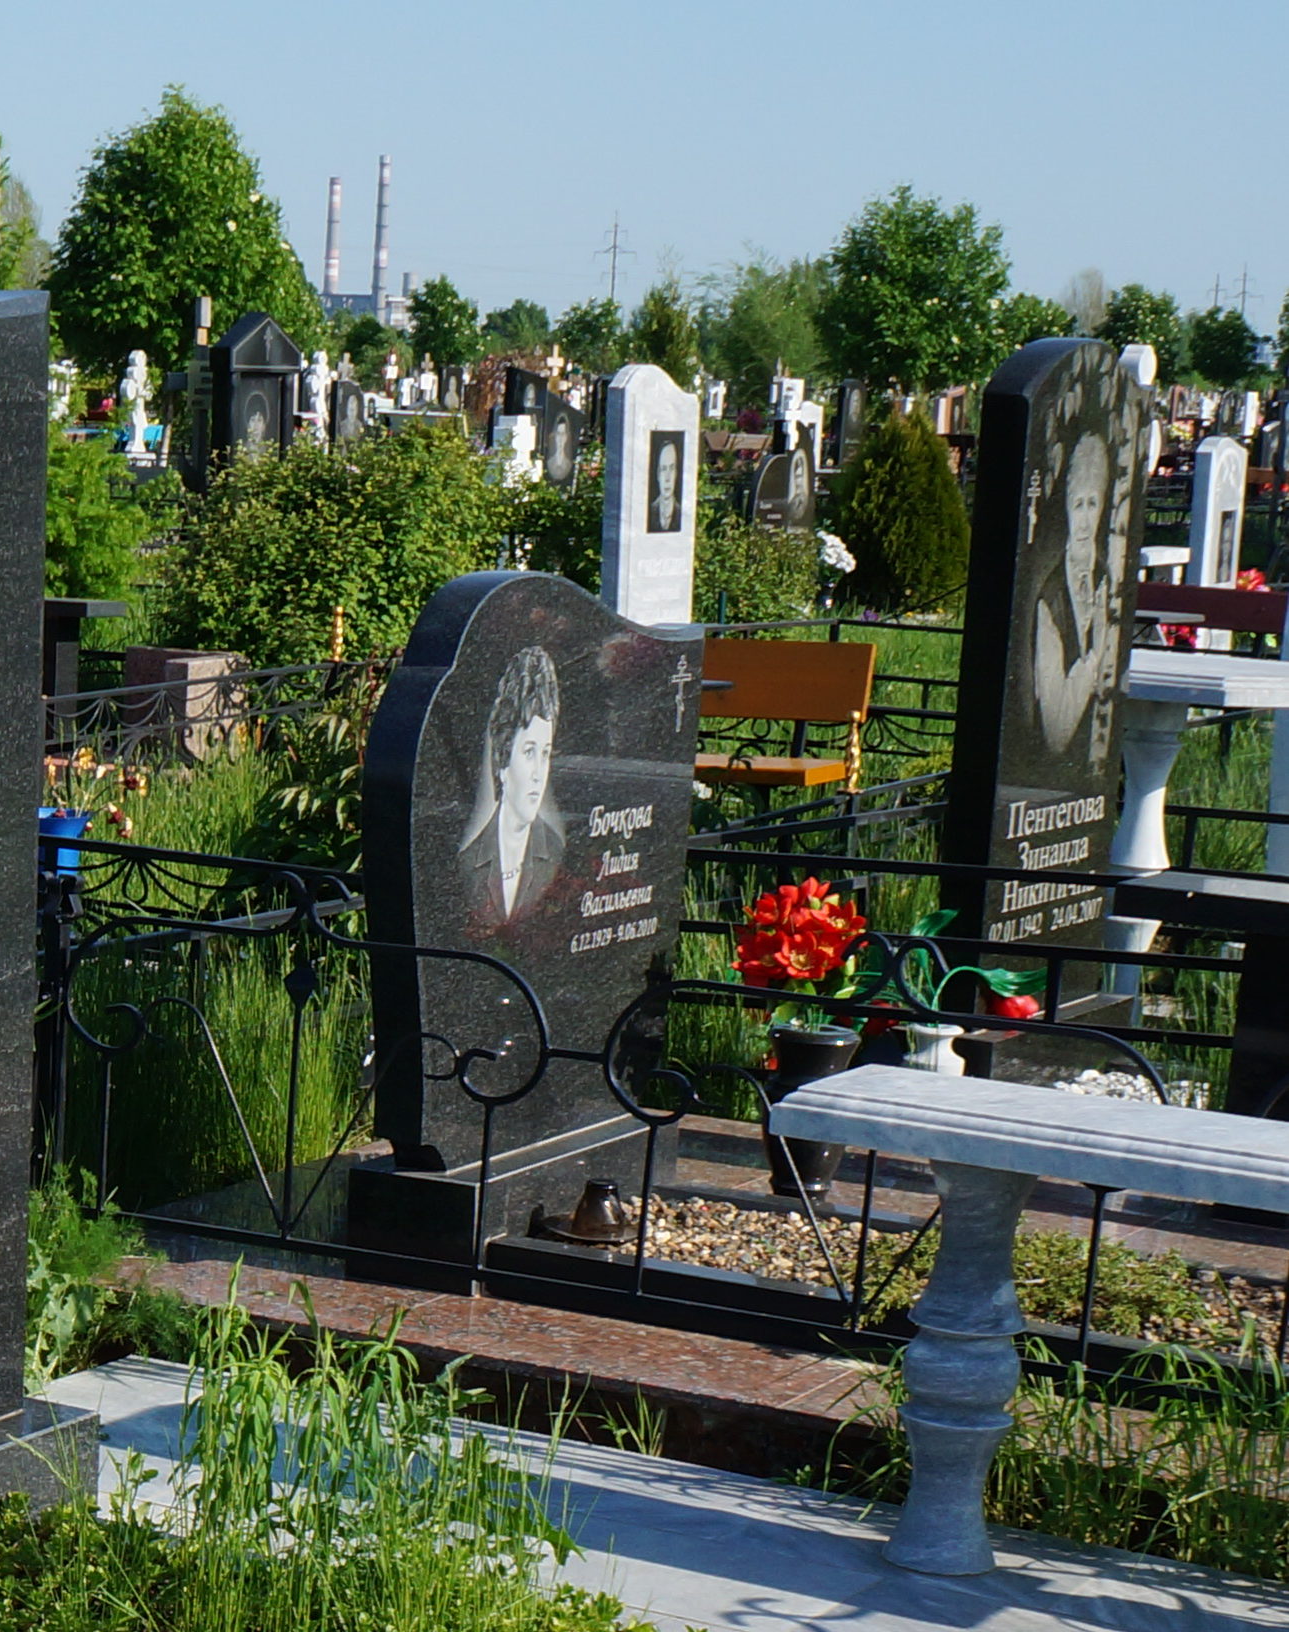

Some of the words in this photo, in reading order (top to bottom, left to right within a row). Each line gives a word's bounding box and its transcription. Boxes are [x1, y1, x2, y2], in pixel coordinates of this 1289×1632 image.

[589, 804, 653, 839] Бочкова
[1006, 795, 1105, 839] Пентегова
[596, 845, 640, 882] Лидия
[1018, 836, 1089, 870] Зинаида
[581, 885, 654, 918] Васильевна
